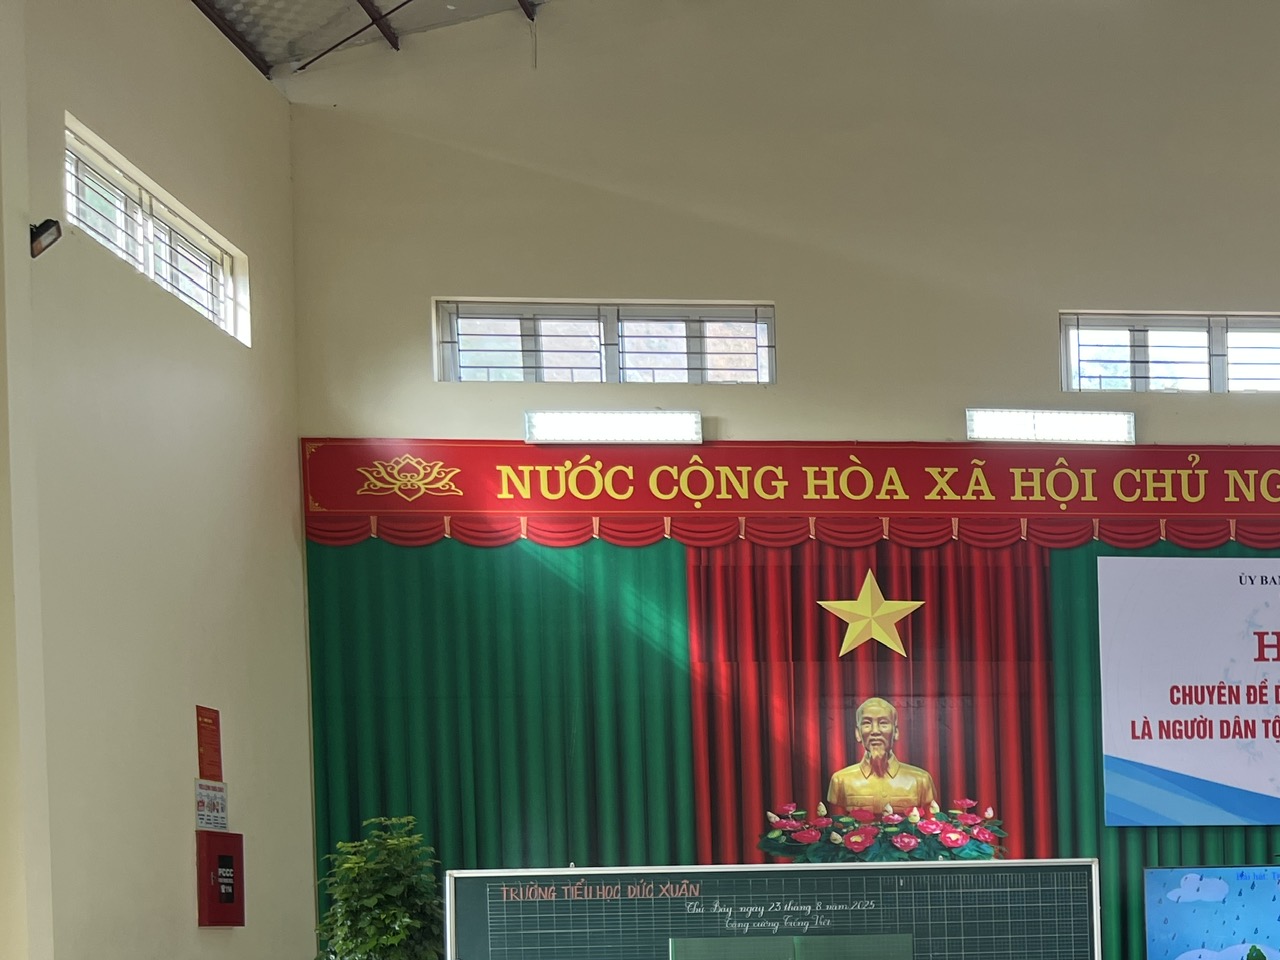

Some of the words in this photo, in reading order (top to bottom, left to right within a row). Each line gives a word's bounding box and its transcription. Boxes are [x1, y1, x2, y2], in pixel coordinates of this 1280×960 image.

[497, 455, 633, 500] NƯỚC
[649, 455, 788, 508] CỘNG
[804, 456, 909, 499] HÒA
[926, 461, 995, 499] XÃ
[1013, 458, 1096, 509] HỘI
[1114, 457, 1206, 502] CHỦ
[1238, 573, 1258, 586] ỦY
[1169, 681, 1241, 706] CHUYÊN
[1246, 679, 1268, 705] ĐỀ
[1131, 715, 1153, 740] LÀ
[1159, 715, 1214, 740] NGƯỜI
[1219, 717, 1257, 739] DÂN
[501, 882, 557, 901] TRƯỜNG
[562, 879, 594, 900] TIỂU
[597, 884, 620, 902] HỌC
[659, 879, 699, 898] XUÂN
[739, 904, 765, 918] ngày
[768, 902, 781, 912] 23
[784, 900, 812, 916] tháng
[816, 902, 822, 911] 8
[850, 900, 876, 910] 2025
